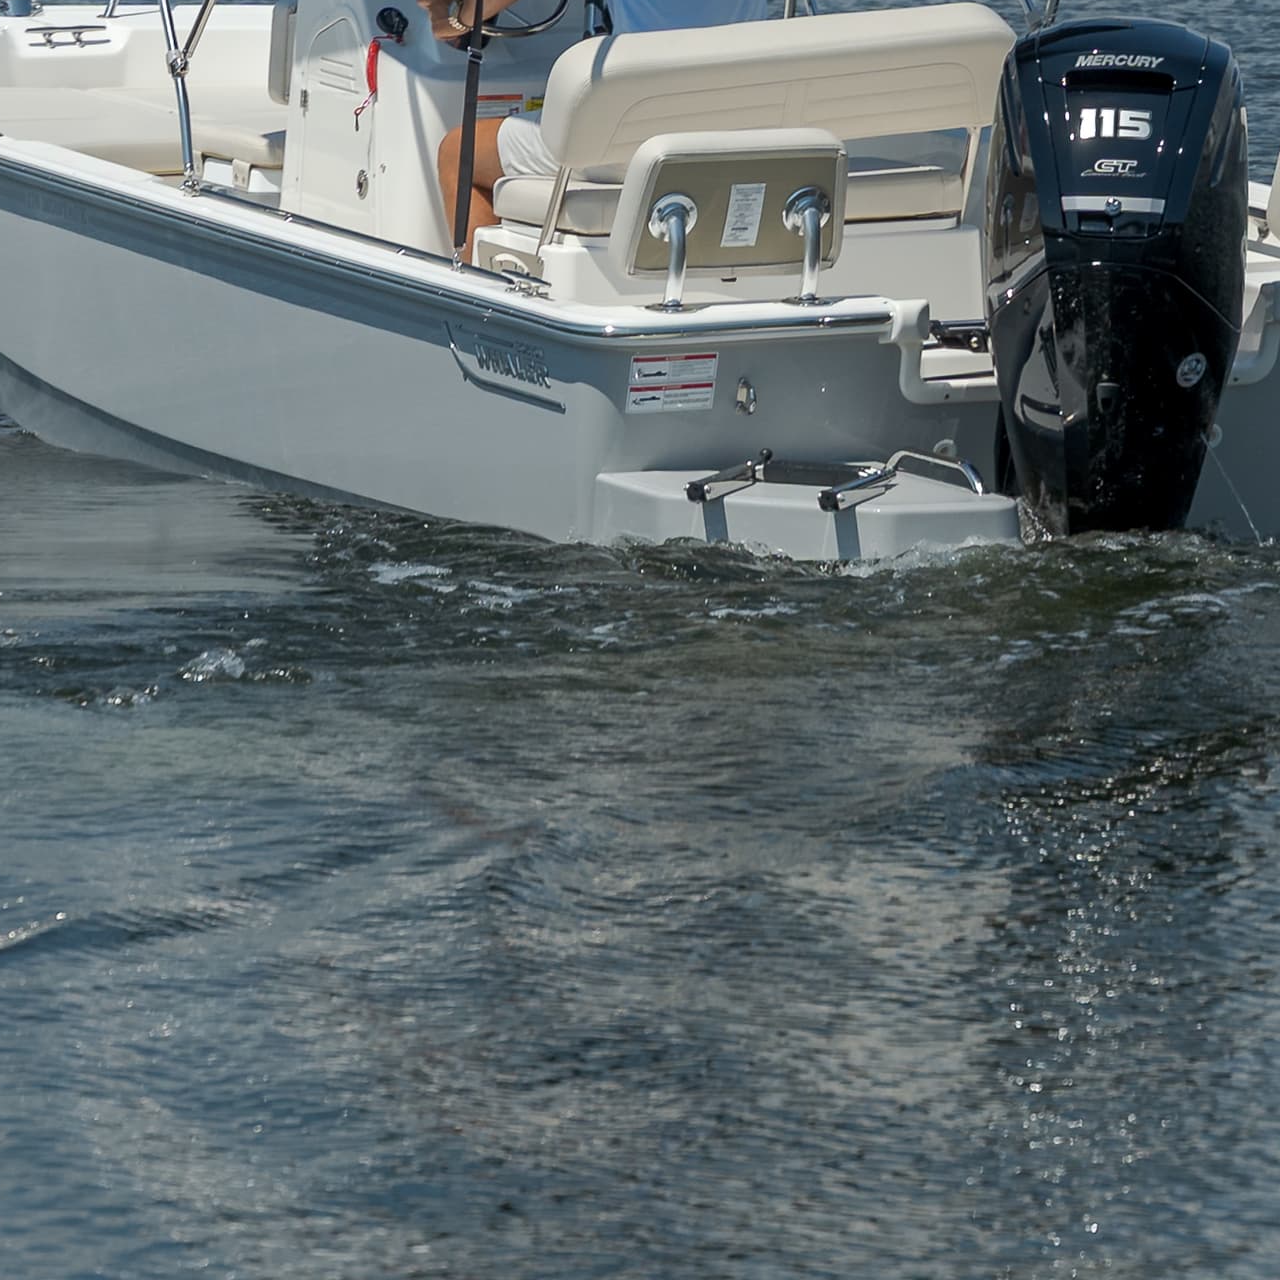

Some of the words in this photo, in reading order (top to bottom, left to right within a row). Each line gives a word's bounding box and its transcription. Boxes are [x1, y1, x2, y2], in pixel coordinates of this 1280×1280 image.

[1074, 54, 1165, 68] MERCURY
[1079, 108, 1152, 140] 115
[1094, 159, 1138, 173] GT
